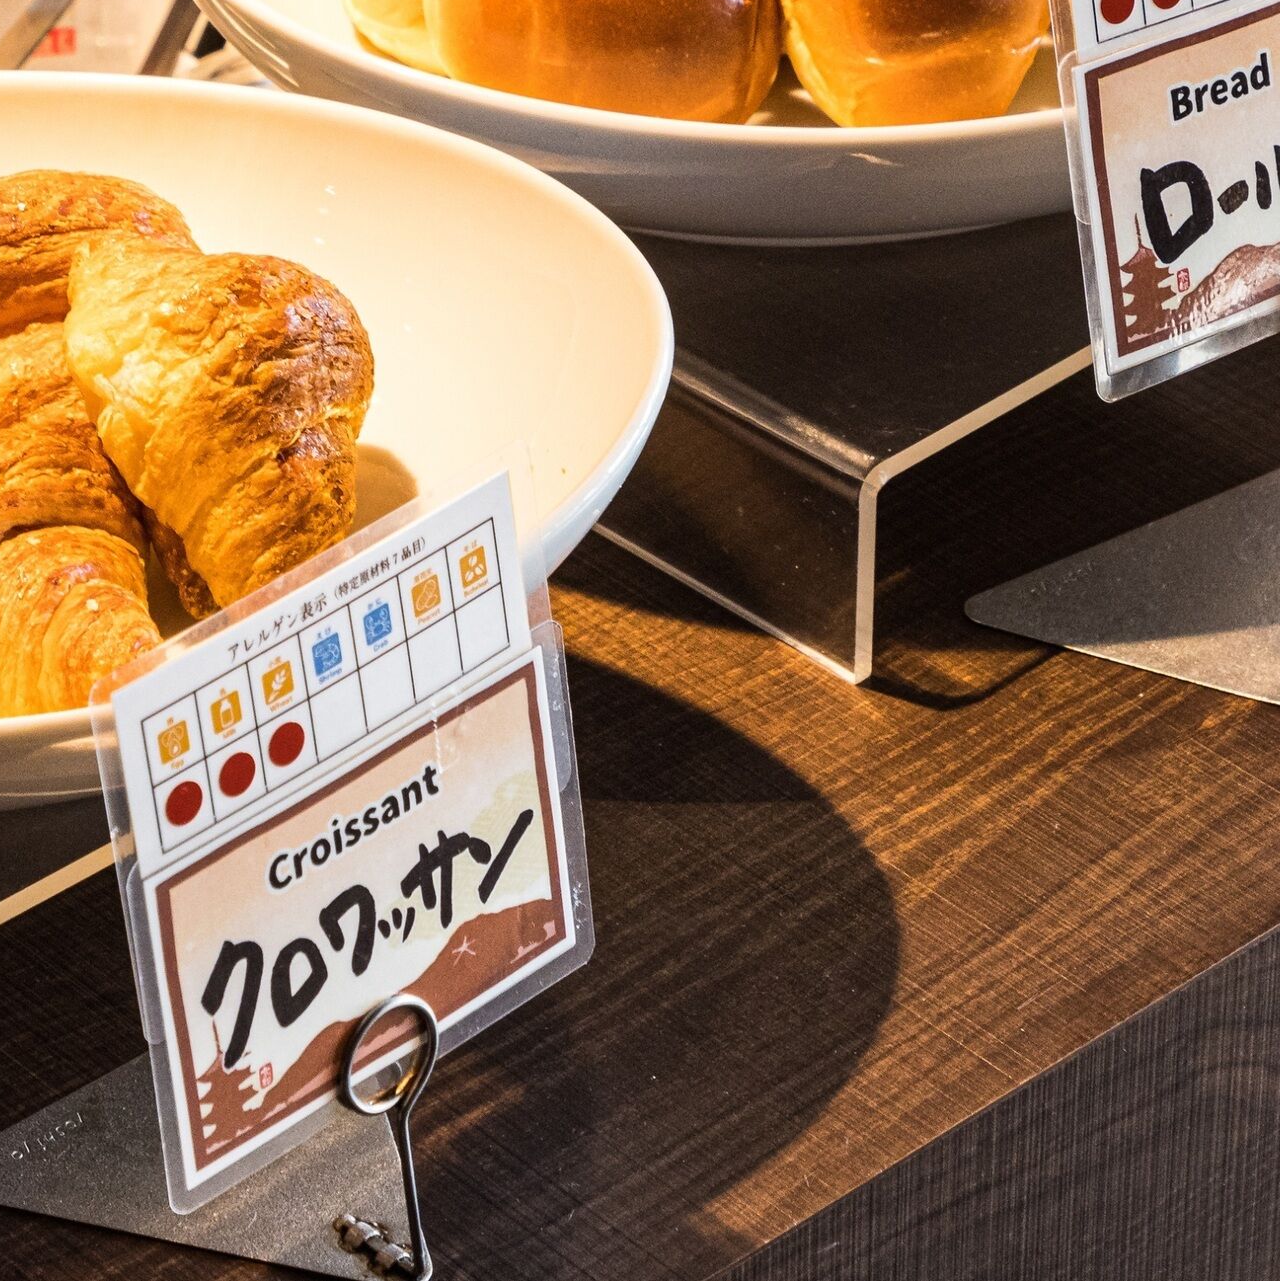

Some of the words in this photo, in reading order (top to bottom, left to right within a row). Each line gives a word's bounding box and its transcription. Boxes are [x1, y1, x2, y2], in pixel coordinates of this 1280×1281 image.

[1171, 52, 1271, 121] Bread
[269, 766, 440, 889] Croissant
[201, 809, 534, 1070] クロワッサン
